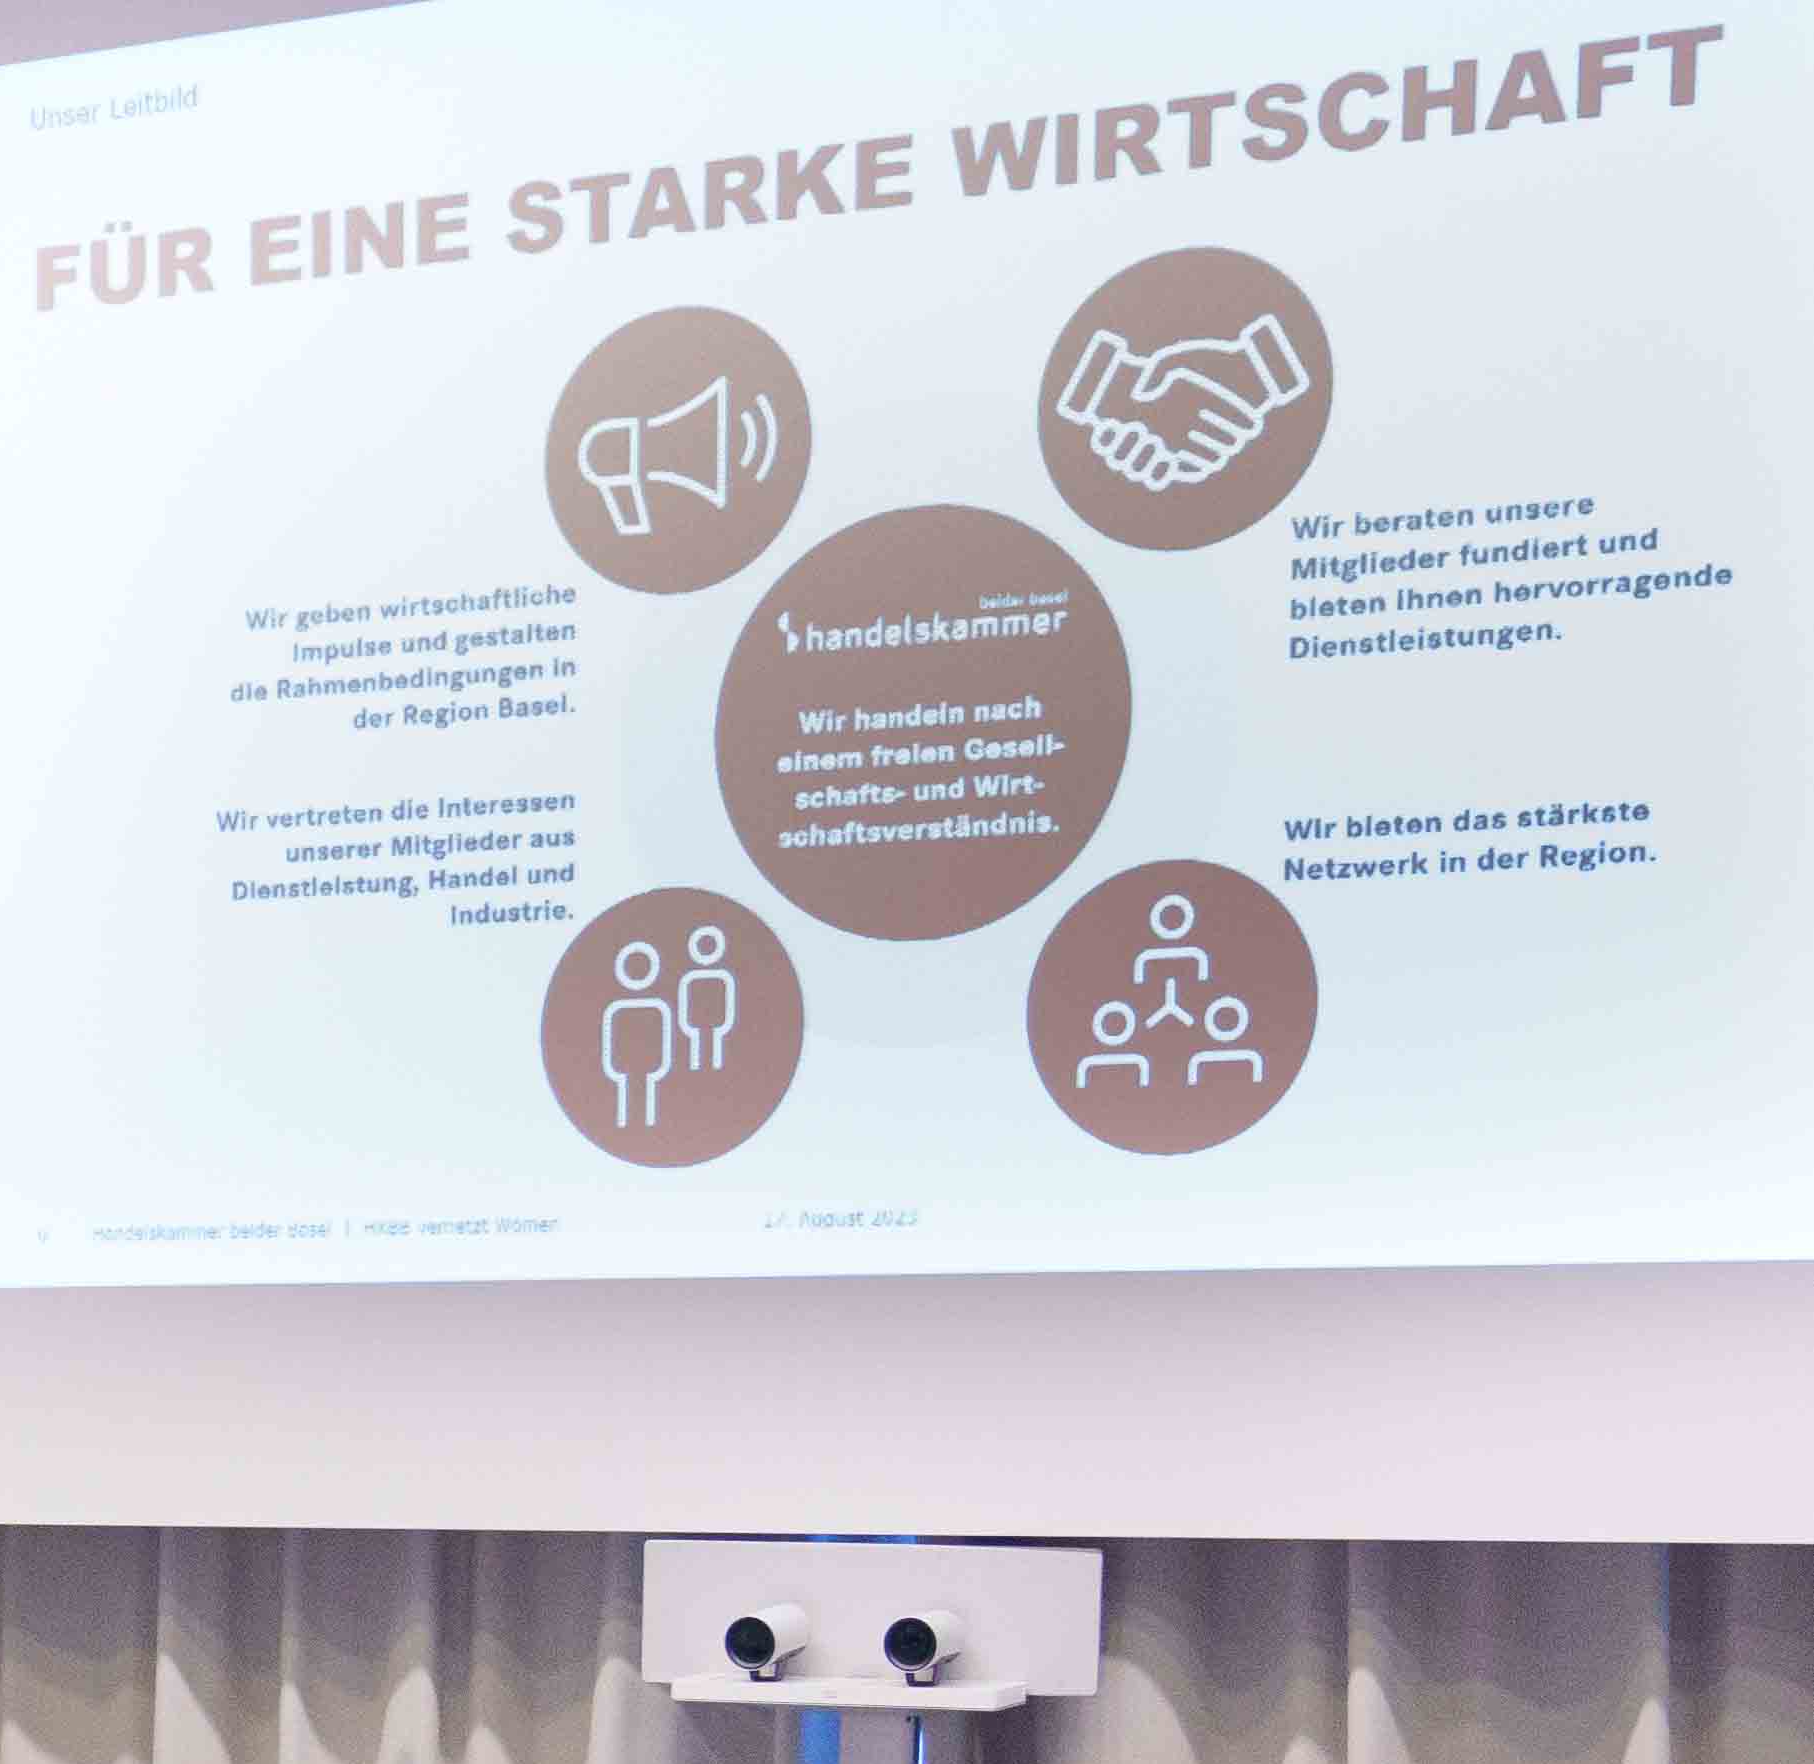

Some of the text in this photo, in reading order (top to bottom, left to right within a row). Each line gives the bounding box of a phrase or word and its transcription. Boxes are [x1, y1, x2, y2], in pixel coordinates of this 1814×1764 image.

[30, 83, 198, 131] Unser Leitbild
[35, 24, 1724, 312] FÜR EINE STARKE WIRTSCHAFT
[1291, 497, 1595, 540] Wir beraten unsere
[1291, 528, 1659, 584] Mitglieder fundiert und
[245, 584, 576, 632] Wir geben wirtschaftliche
[1290, 564, 1733, 620] bieten Ihnen hervorragende
[292, 622, 576, 665] Impulse und gestalten
[806, 610, 1069, 652] handelskammer
[1289, 620, 1562, 660] Dienstleistungen.
[230, 658, 576, 702] die Rahmenbedingungen in
[353, 693, 576, 729] der Region Basel.
[798, 694, 1042, 734] Wir handeln nach
[777, 733, 1065, 773] einem freien Gesell-
[794, 774, 1045, 809] schafts- und Wirt-
[216, 794, 576, 832] Wir vertreten die Interessen
[778, 810, 1060, 848] schaftsverständnis.
[1284, 802, 1650, 841] Wir bieten das stärkste
[286, 830, 576, 863] unserer Mitglieder aus
[1284, 840, 1657, 881] Netzwerk in der Region.
[232, 863, 575, 900] Dienstleistung, Handel und
[451, 900, 575, 925] Industrie.
[799, 1209, 865, 1229] August
